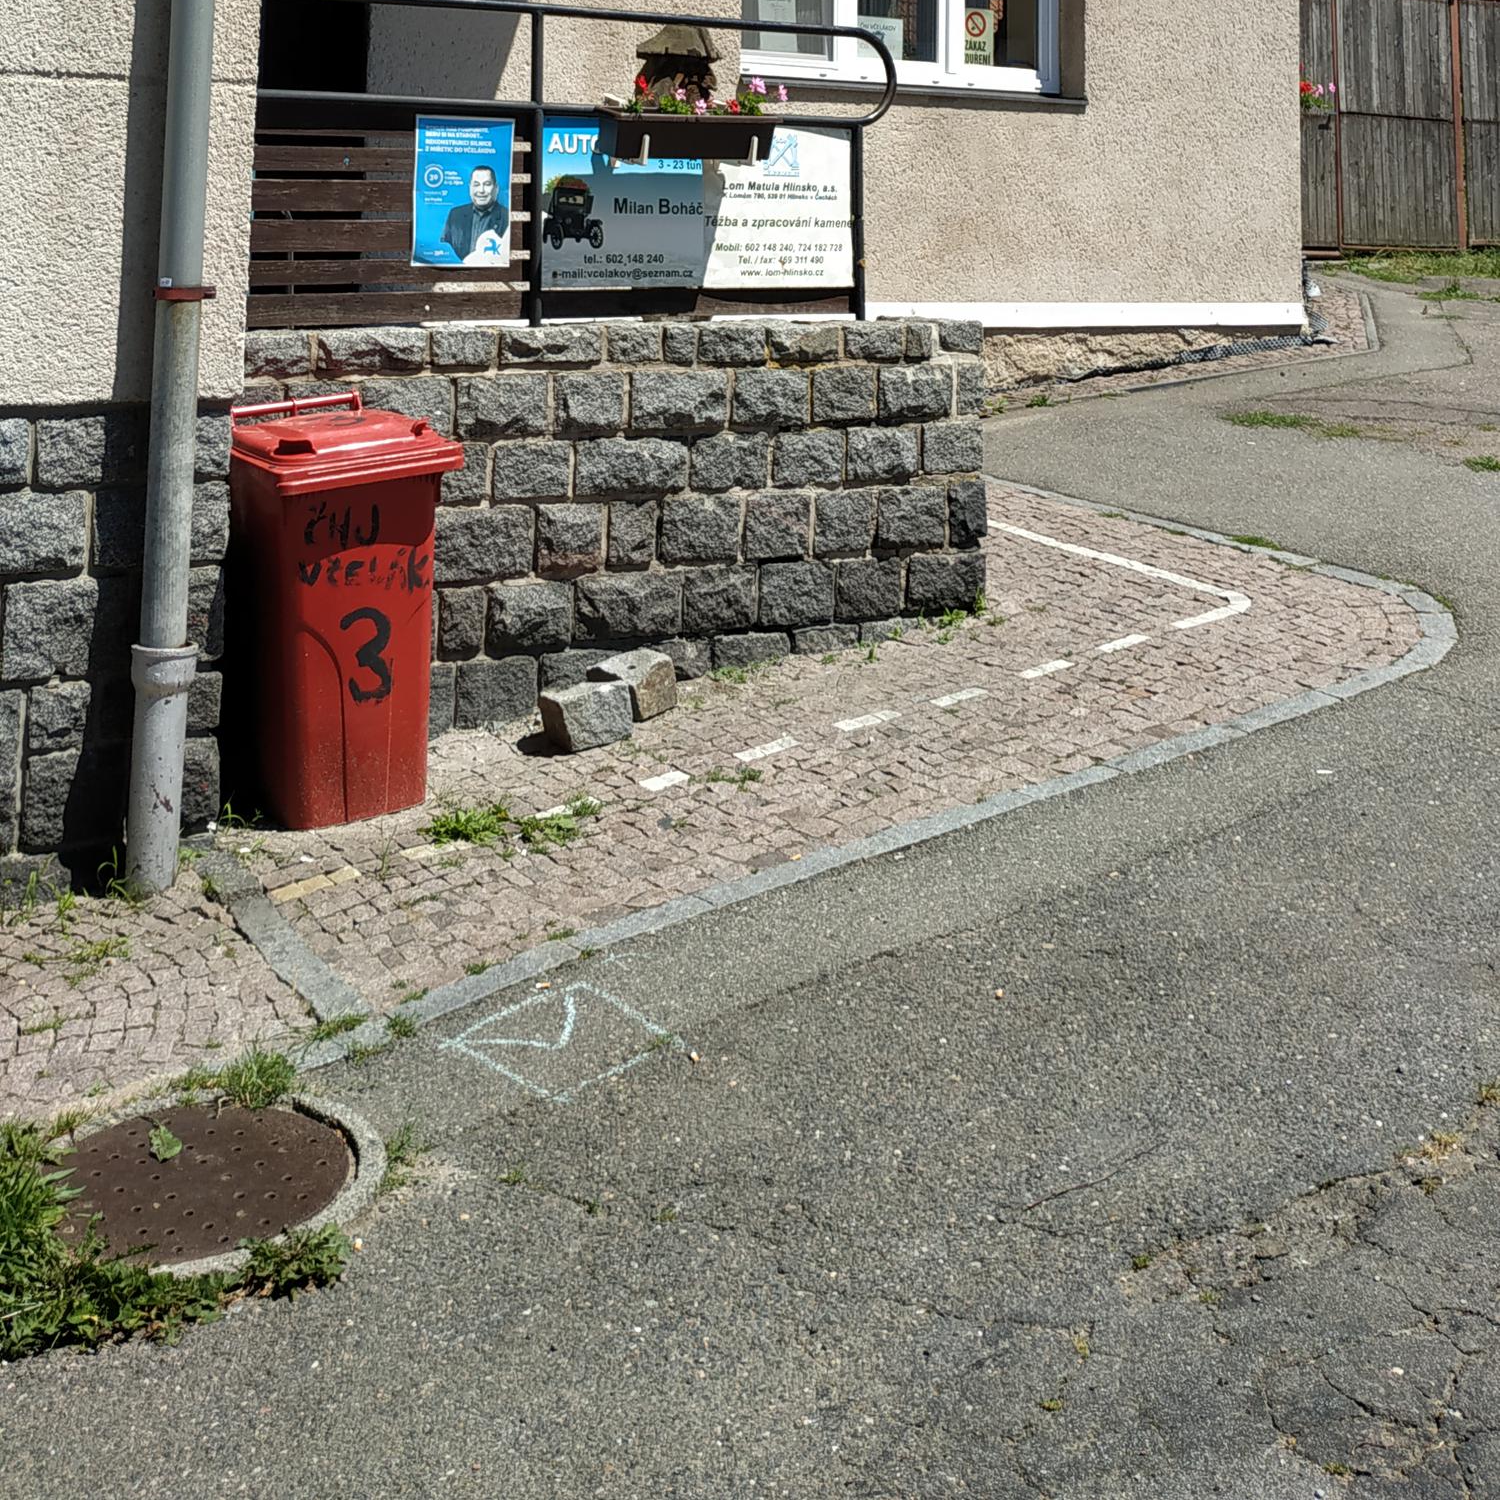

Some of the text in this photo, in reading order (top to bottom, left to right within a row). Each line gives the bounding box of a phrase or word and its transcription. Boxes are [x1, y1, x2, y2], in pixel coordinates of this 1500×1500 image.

[965, 38, 986, 52] ZÁKAZ
[965, 52, 991, 66] OUŘENÍ
[658, 160, 664, 169] 3
[673, 160, 684, 169] 23
[722, 182, 745, 190] Lom
[748, 181, 780, 191] Matula
[783, 183, 819, 194] Hlinsko,
[614, 198, 703, 215] Milan Boháč
[705, 215, 738, 228] Těžba
[742, 218, 748, 227] a
[752, 217, 811, 230] zpracování
[715, 243, 742, 252] Mobil:
[745, 243, 759, 251] 602
[780, 244, 795, 252] 240,
[584, 254, 665, 264] tel.: 602 148 240
[760, 255, 776, 264] fax:
[795, 256, 808, 264] 311
[810, 256, 824, 264] 490
[340, 606, 392, 706] 3
